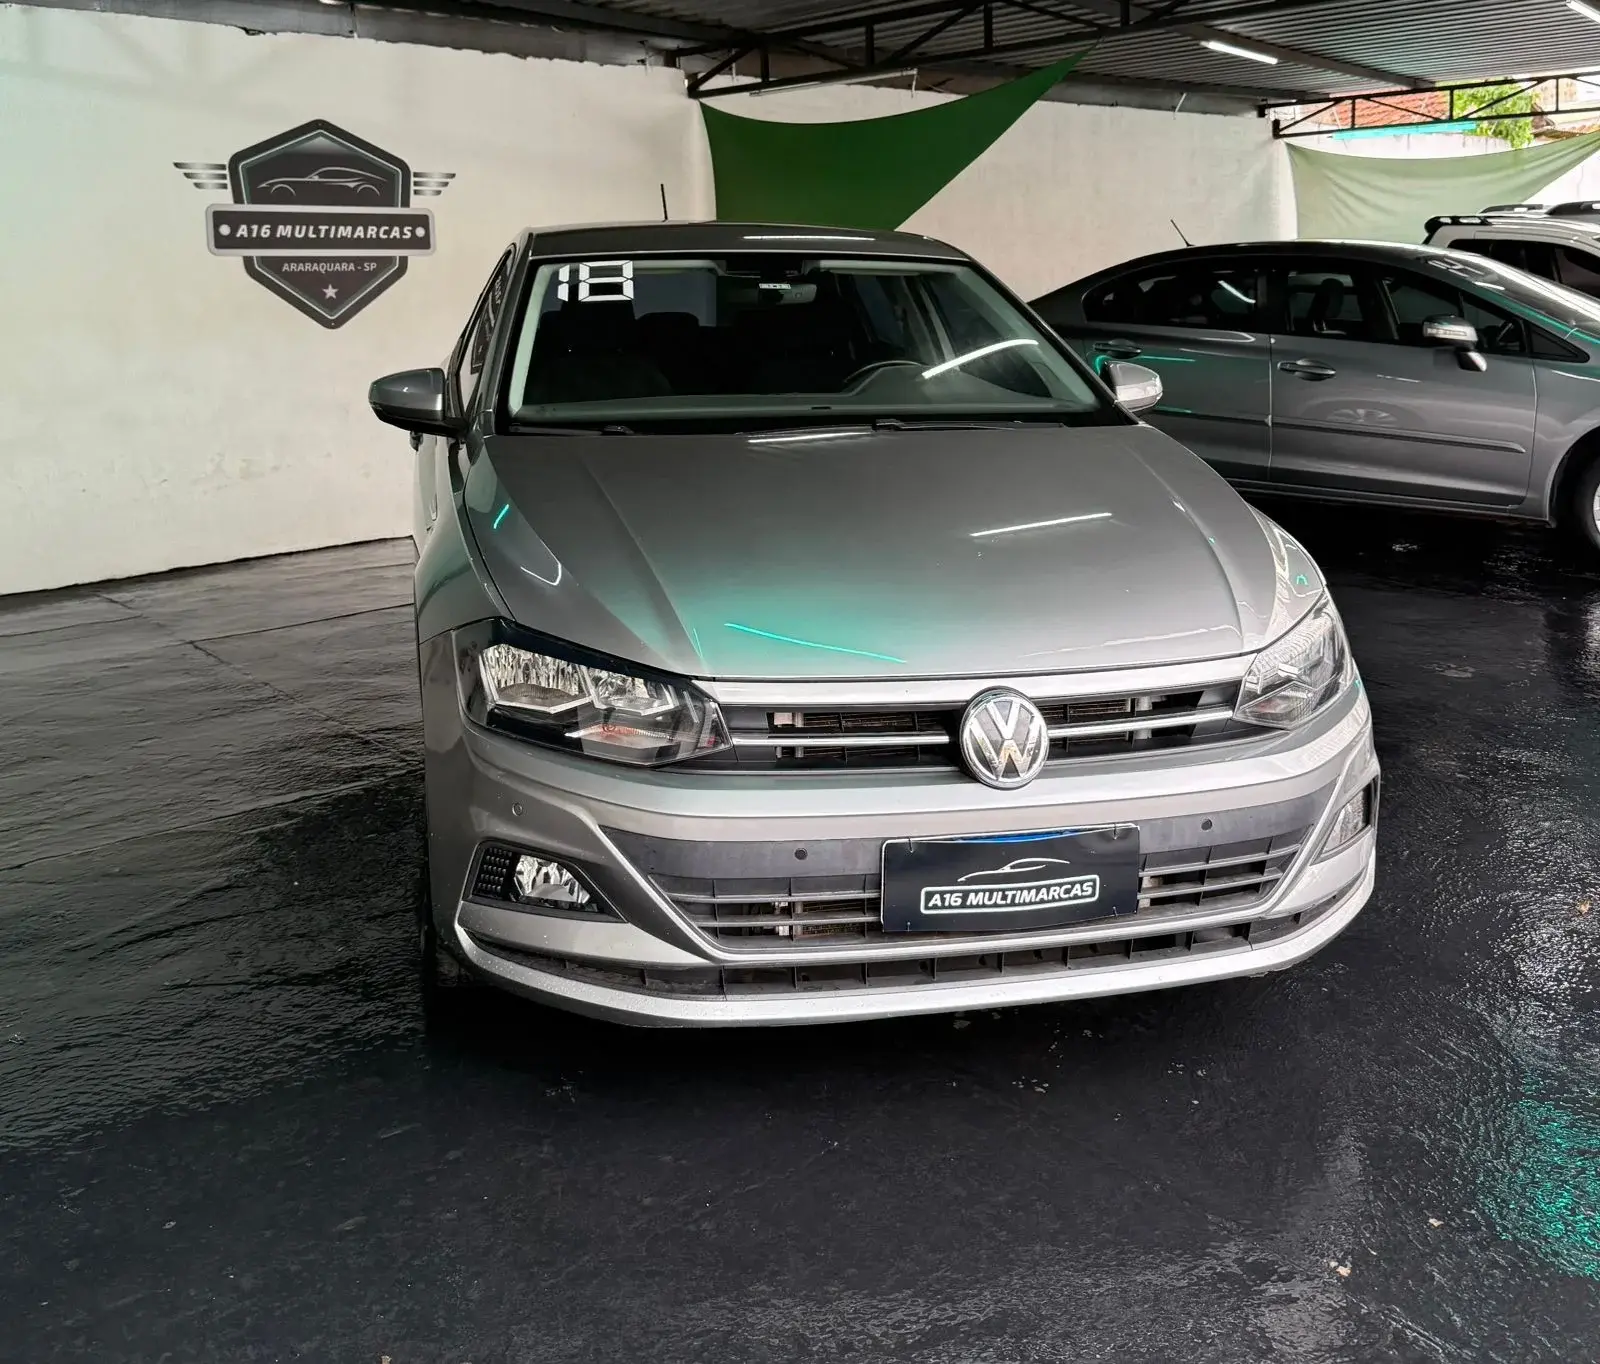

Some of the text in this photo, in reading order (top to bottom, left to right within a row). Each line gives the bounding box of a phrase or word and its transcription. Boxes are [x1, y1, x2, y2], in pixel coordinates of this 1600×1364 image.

[236, 224, 412, 239] A16 MULTIMARCAS
[282, 262, 354, 273] ARARAQUARA
[363, 263, 378, 272] SP
[557, 260, 634, 301] 18
[928, 881, 1093, 907] A16 MULTIMARCAS
